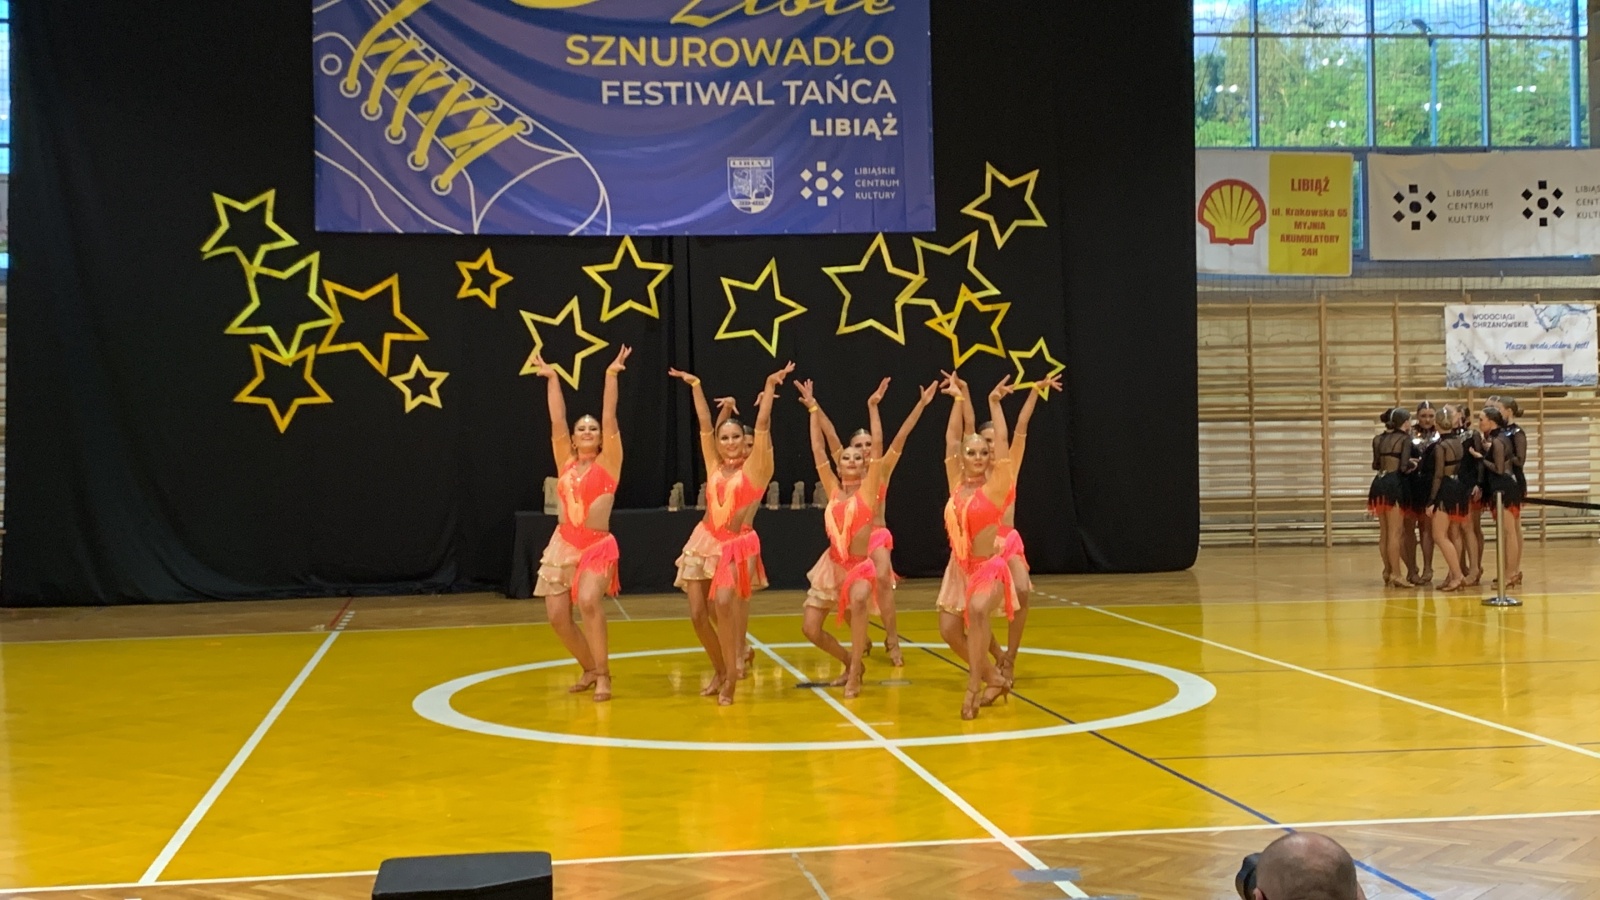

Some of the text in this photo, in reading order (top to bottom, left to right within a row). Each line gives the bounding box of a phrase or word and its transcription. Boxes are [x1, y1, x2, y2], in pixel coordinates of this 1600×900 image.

[565, 35, 895, 67] SZNUROWADŁO
[601, 74, 897, 106] FESTIWAL TAŃCA
[810, 112, 898, 141] LIBIĄŻ
[854, 167, 896, 176] LIBIĄSKIE
[854, 179, 900, 187] CENTRUM
[1290, 176, 1331, 196] LIBIĄŻ
[855, 191, 896, 200] KULTURY
[1446, 188, 1490, 198] LIBIĄSKIE
[1447, 202, 1493, 211] CENTRUM
[1272, 208, 1283, 217] ul.
[1285, 208, 1335, 217] Krakowska
[1448, 215, 1490, 224] KULTURY
[1294, 221, 1326, 230] MYJNIA
[1280, 234, 1340, 243] AKUMULATORY
[1301, 248, 1318, 256] 24H
[1472, 313, 1516, 322] WODOCIĄGI
[1472, 321, 1529, 329] CHRZANOWSKIE
